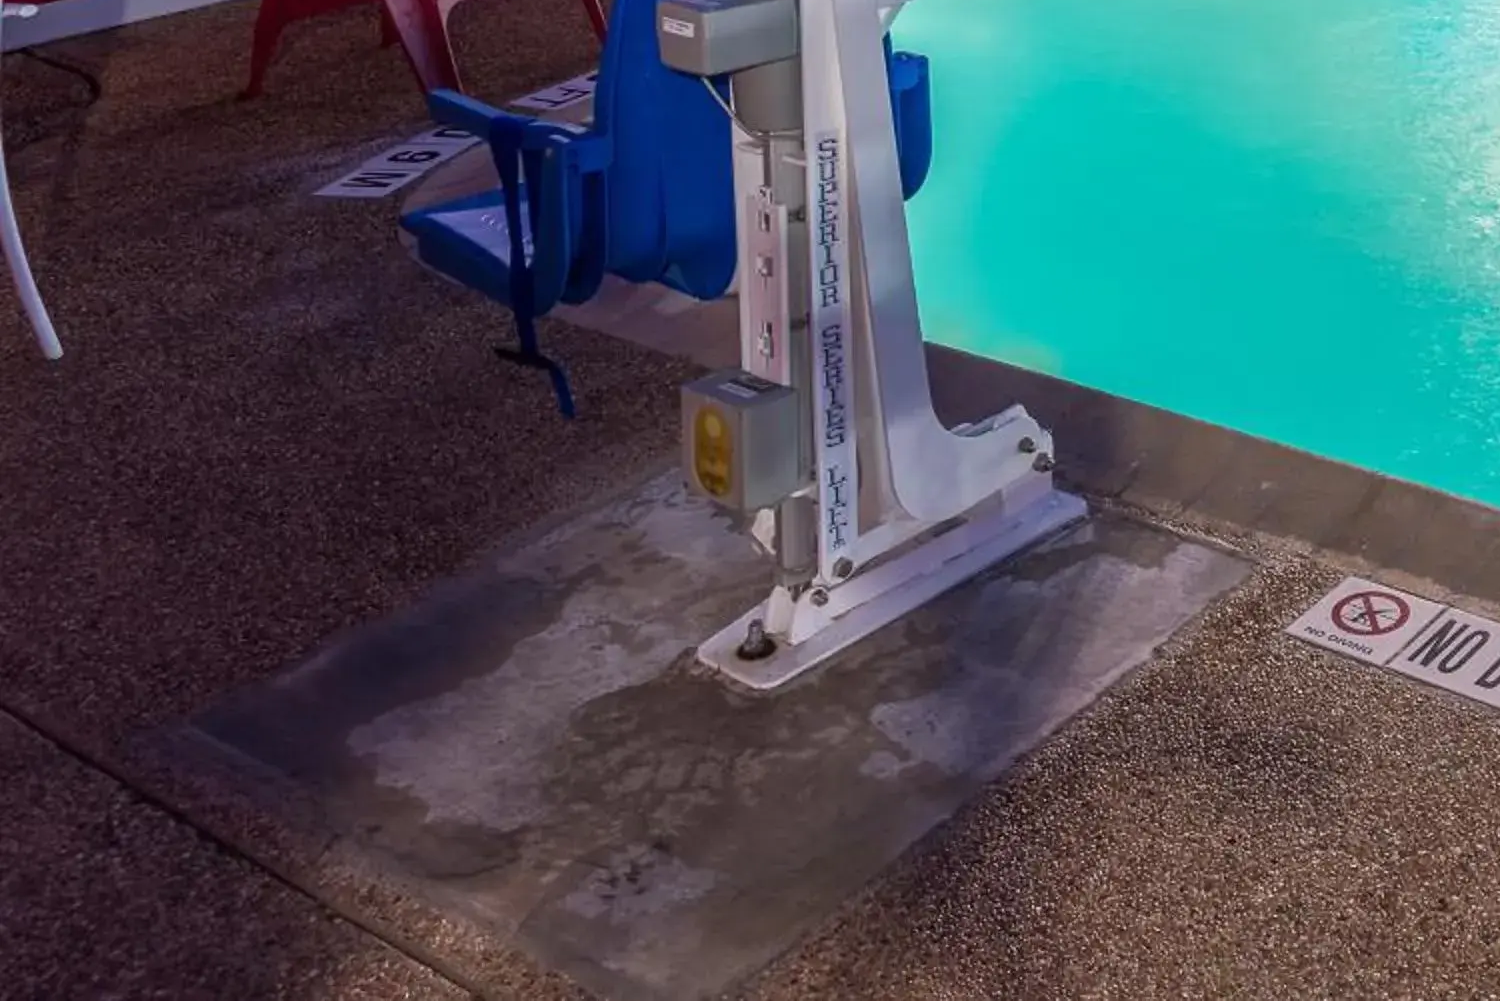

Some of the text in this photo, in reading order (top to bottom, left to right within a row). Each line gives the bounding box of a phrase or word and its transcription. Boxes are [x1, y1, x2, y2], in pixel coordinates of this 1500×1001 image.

[818, 138, 840, 308] SUPERIOR
[822, 324, 845, 448] SERIES
[1408, 618, 1491, 674] NO
